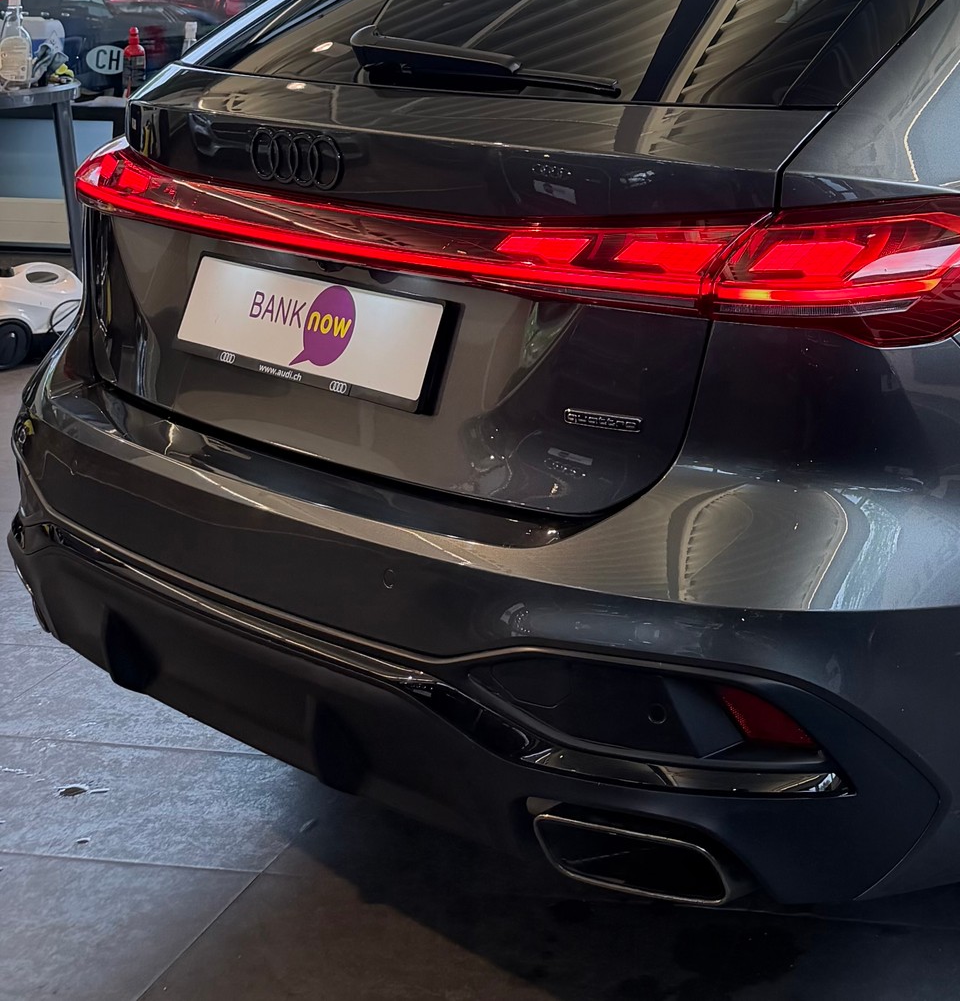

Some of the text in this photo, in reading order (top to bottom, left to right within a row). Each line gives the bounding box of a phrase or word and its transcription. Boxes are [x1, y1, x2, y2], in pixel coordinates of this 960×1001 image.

[95, 49, 121, 71] CH
[249, 291, 352, 339] BANK now
[258, 364, 302, 382] www.audi.ch
